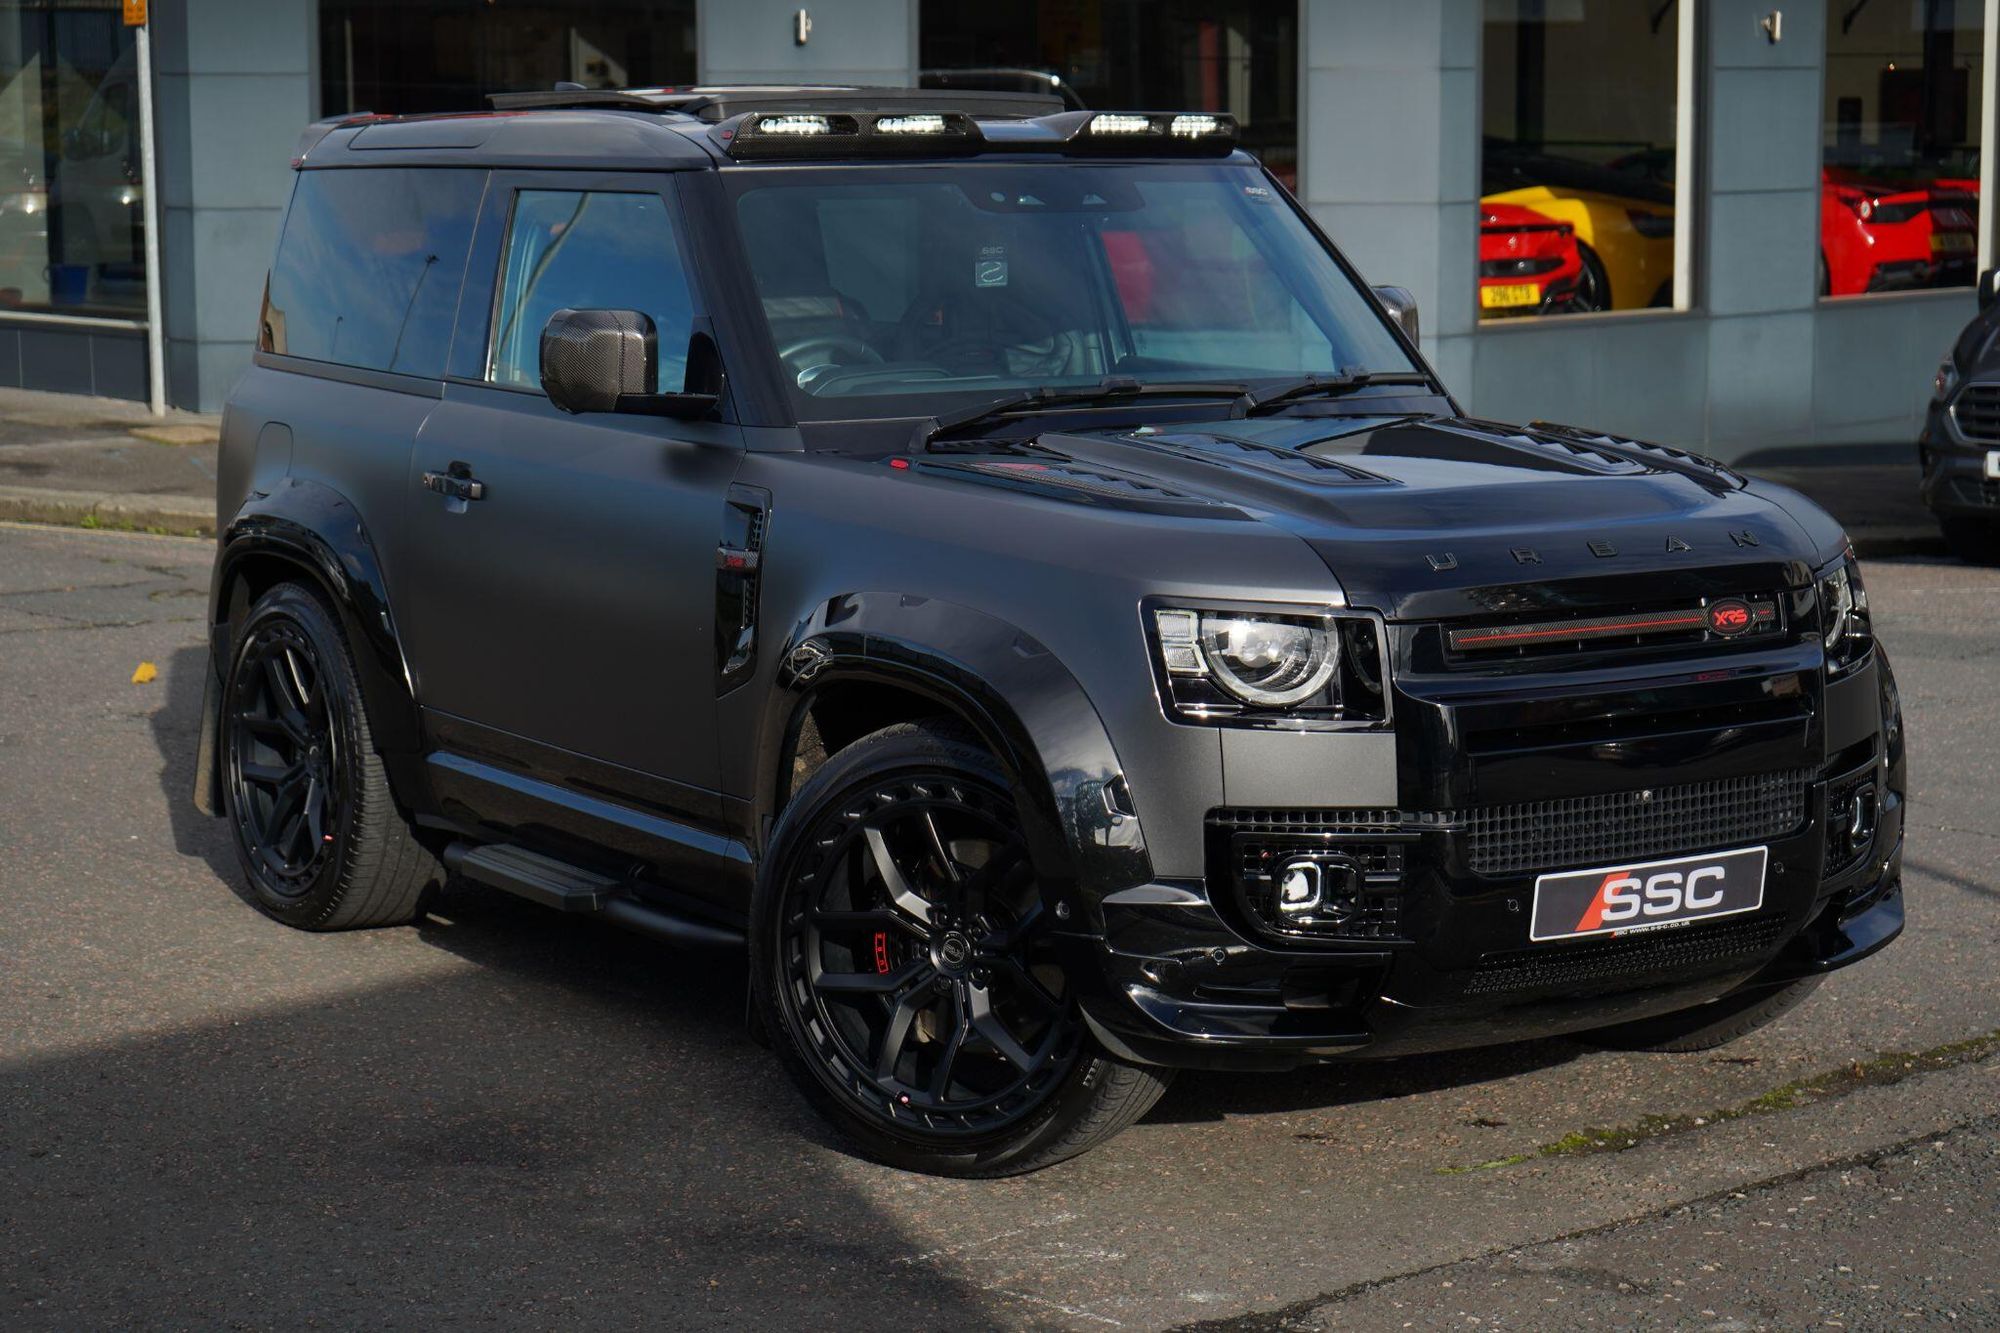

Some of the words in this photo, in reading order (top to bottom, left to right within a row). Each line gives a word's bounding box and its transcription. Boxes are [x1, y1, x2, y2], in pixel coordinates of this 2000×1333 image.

[1425, 529, 1762, 573] URBAN
[1713, 608, 1748, 626] XRS
[1601, 866, 1725, 921] SSC
